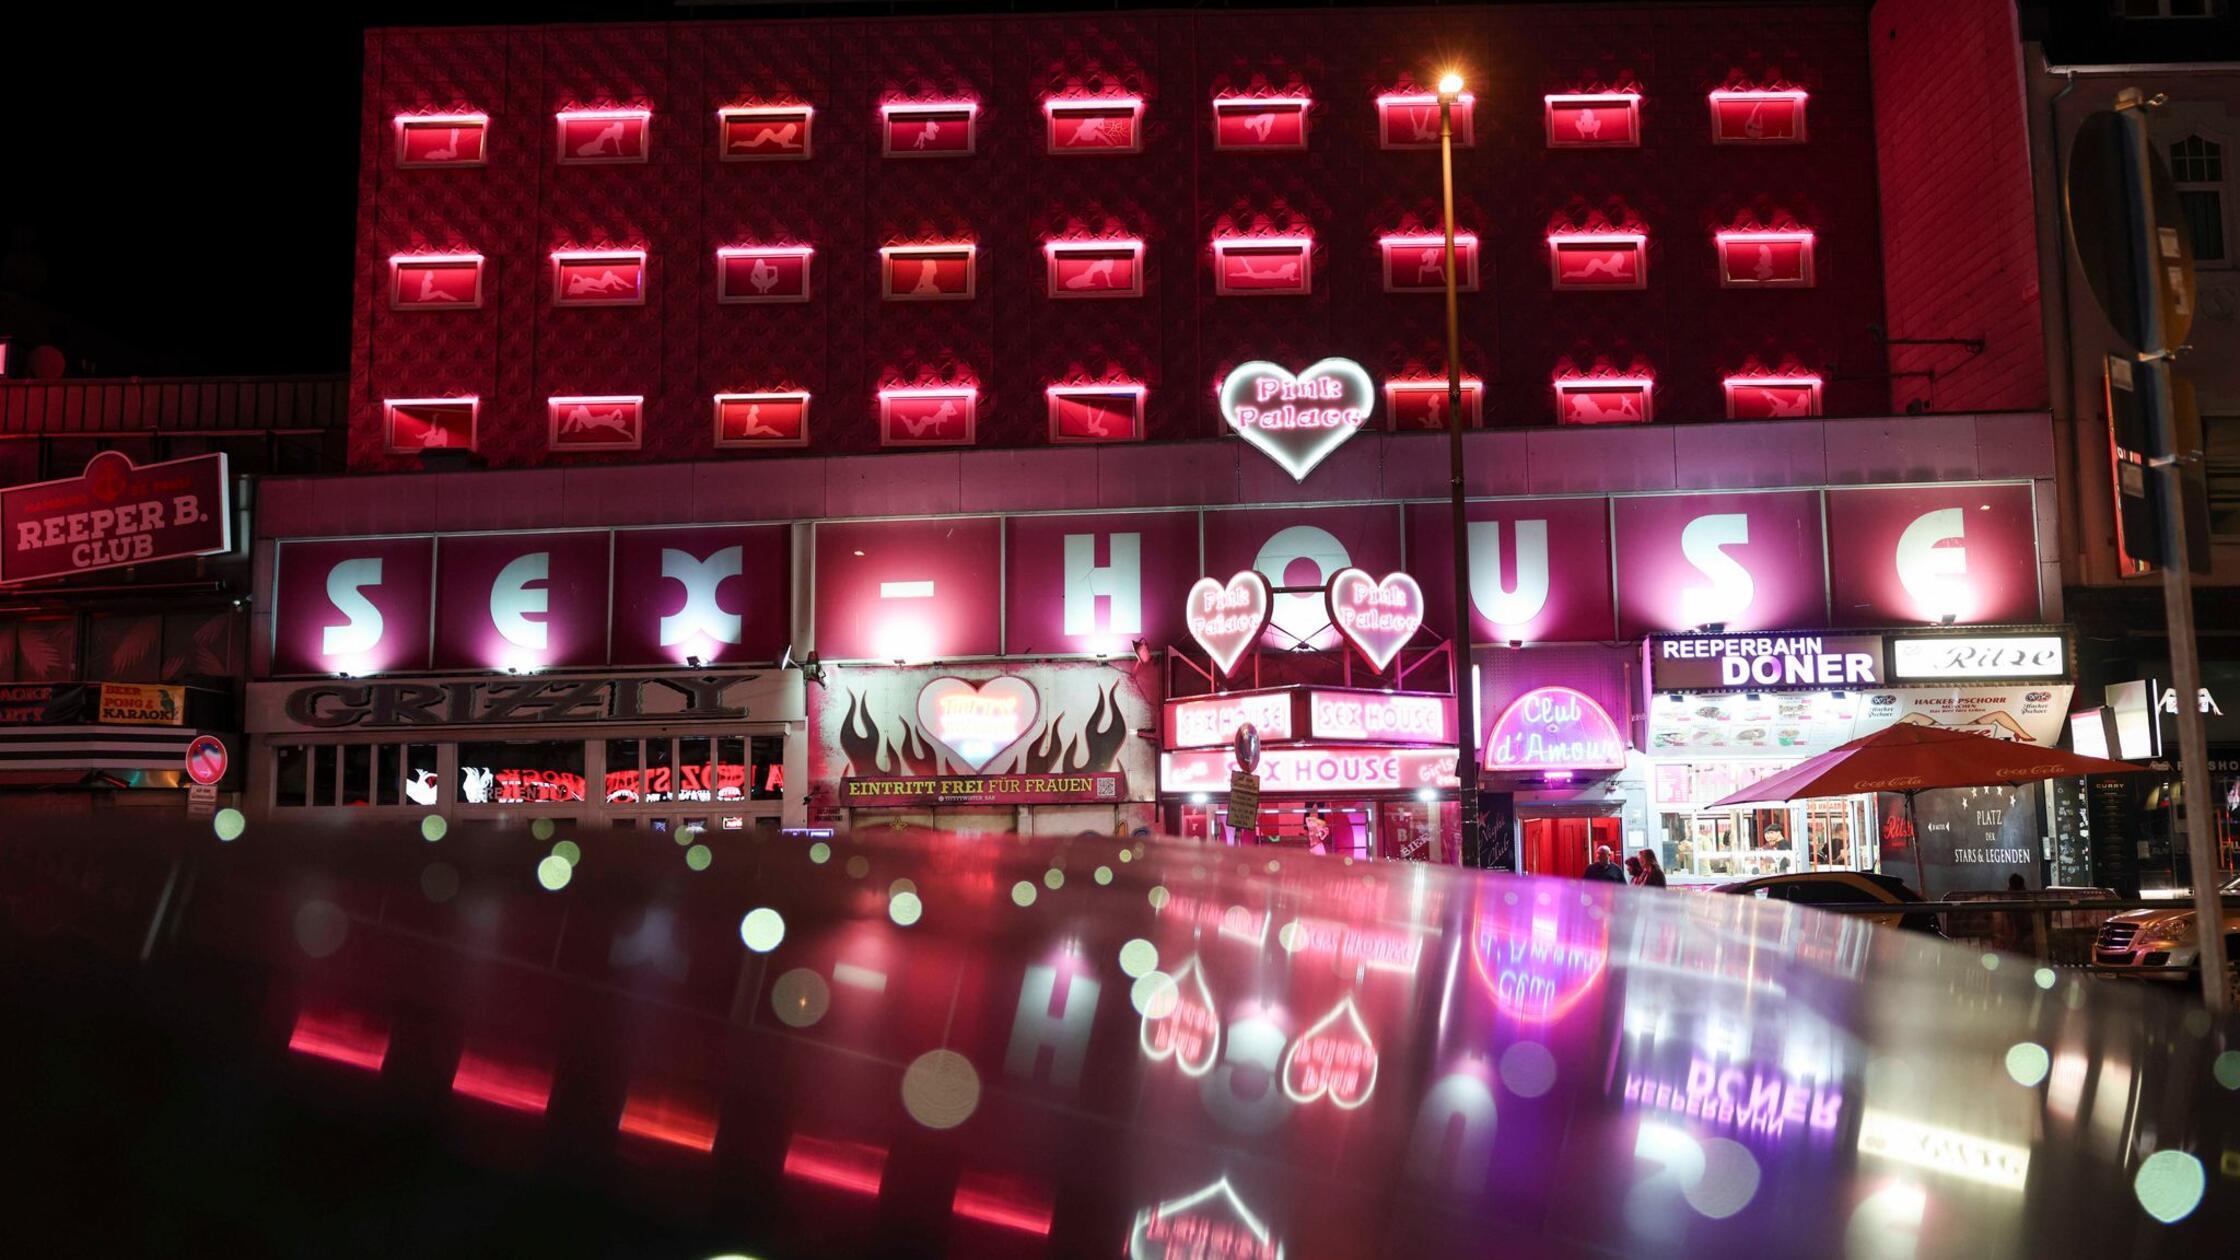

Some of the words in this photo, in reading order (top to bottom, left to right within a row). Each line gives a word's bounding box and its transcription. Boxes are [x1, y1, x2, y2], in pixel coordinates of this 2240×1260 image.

[1256, 376, 1343, 401] Pink
[1235, 405, 1362, 429] Palace
[17, 500, 166, 551] REEPER
[173, 494, 209, 527] B.
[72, 533, 154, 568] CLUB
[1204, 587, 1250, 612] Pink
[1353, 582, 1407, 606] Pink
[1341, 609, 1420, 632] Palace
[1664, 637, 1822, 658] REEPERBAHN
[104, 685, 141, 695] BEER
[285, 674, 762, 728] GRIZZLY
[103, 697, 143, 708] PONG
[145, 698, 154, 709] &
[1524, 694, 1581, 723] Club
[1319, 701, 1363, 726] SEX
[1366, 702, 1437, 730] HOUSE
[1295, 758, 1398, 782] HOUSE
[1419, 757, 1455, 782] Girls
[849, 780, 936, 796] EINTRITT
[940, 780, 984, 795] FREI
[988, 776, 1021, 793] FÜR
[1024, 778, 1094, 793] FRAUEN
[1976, 809, 2002, 826] PLATZ
[1955, 849, 1977, 863] STARS
[1978, 849, 1984, 863] &
[1985, 849, 2031, 863] LEGENDEN
